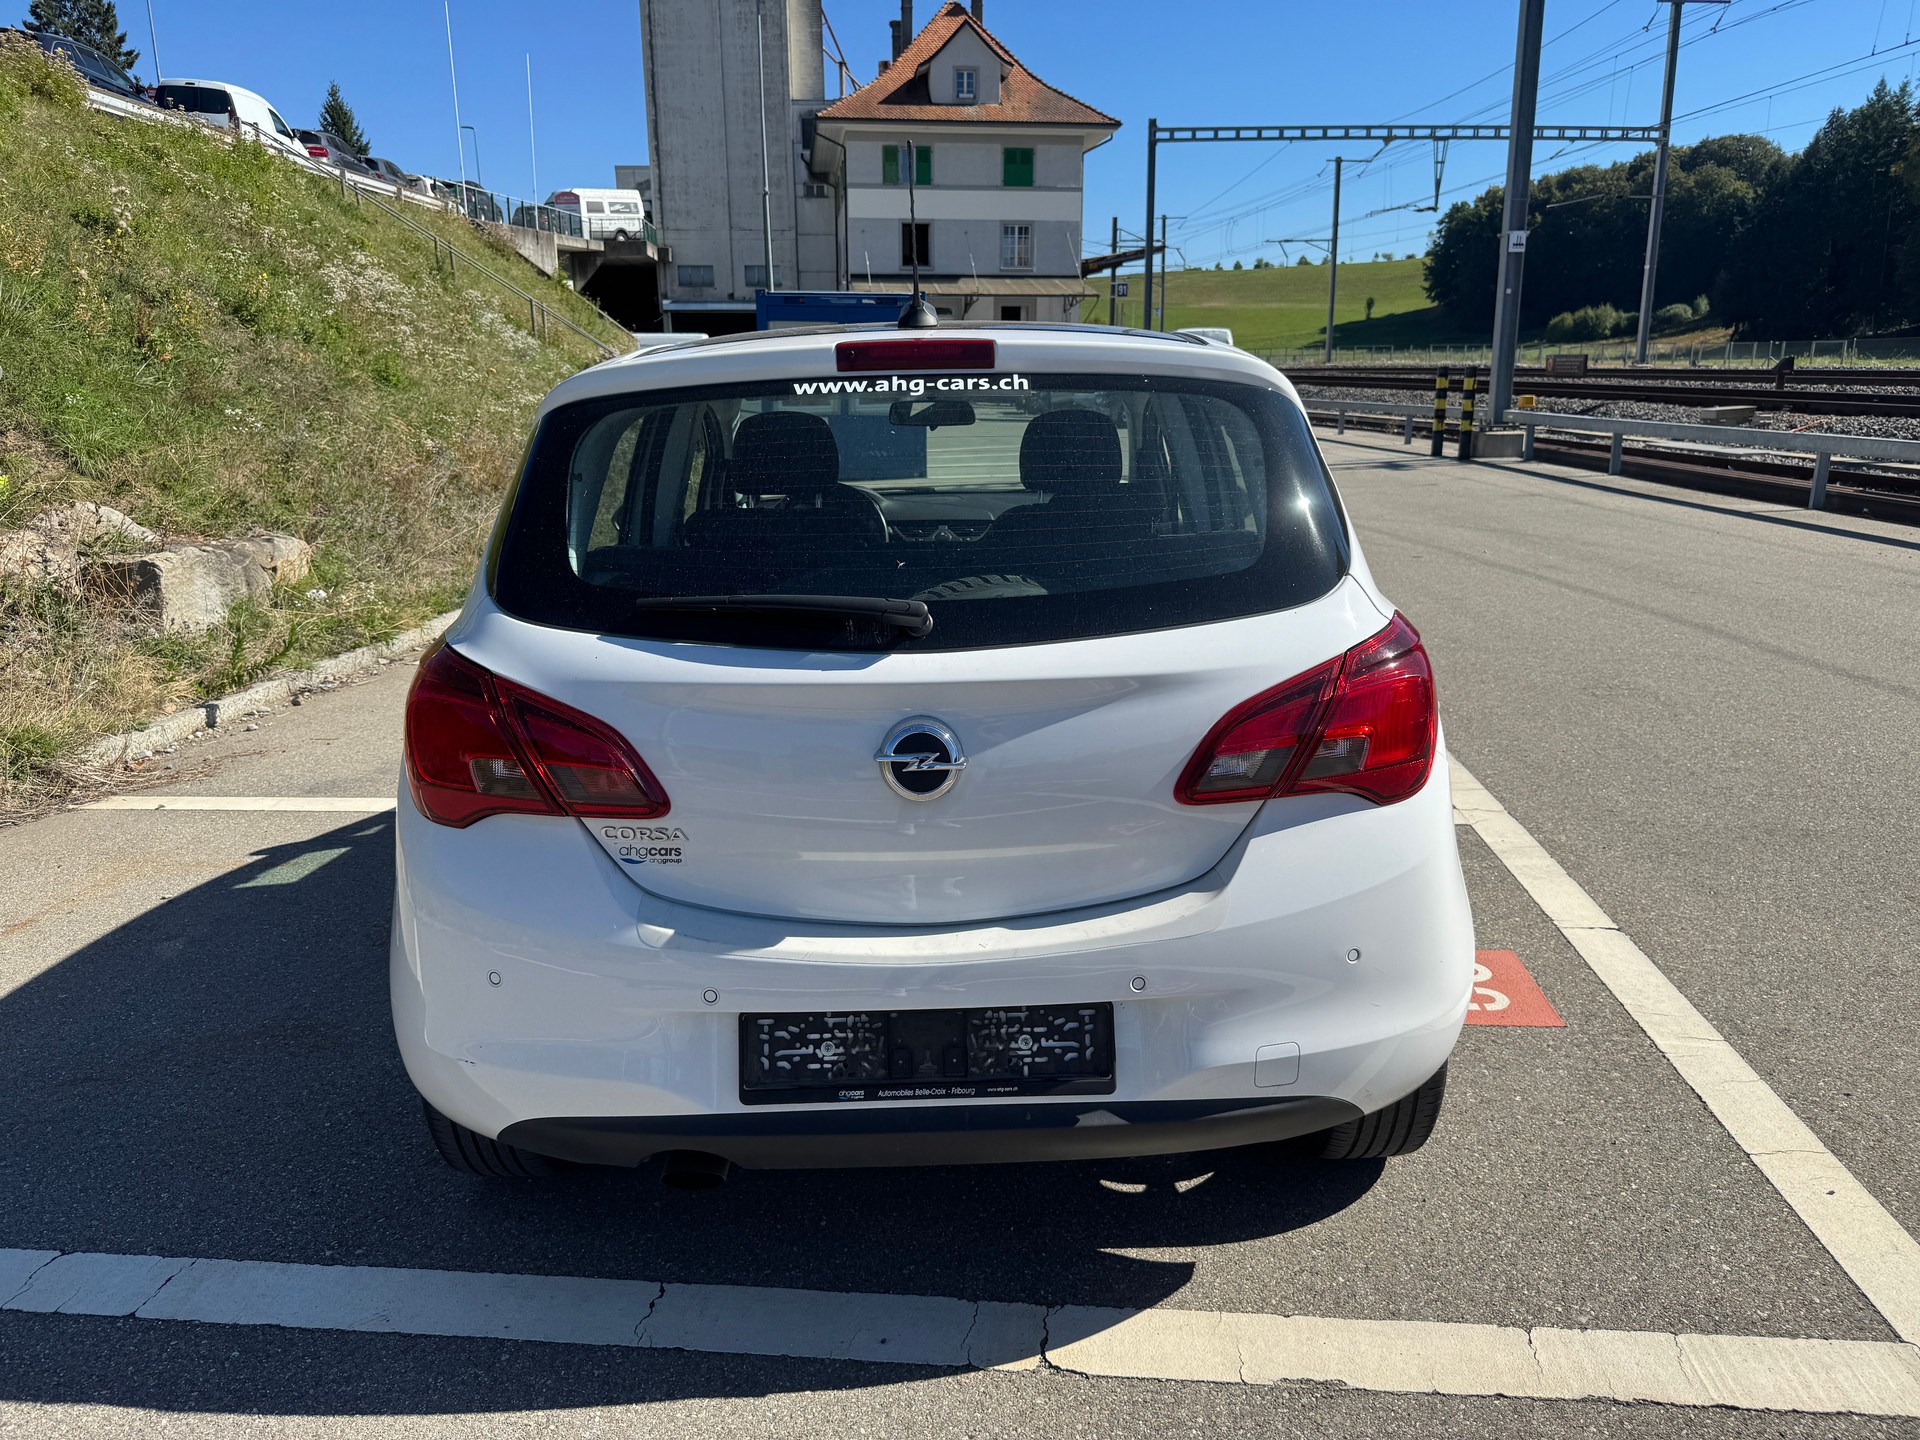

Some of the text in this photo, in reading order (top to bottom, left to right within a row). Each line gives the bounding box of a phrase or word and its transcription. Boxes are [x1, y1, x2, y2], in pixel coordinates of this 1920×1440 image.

[1118, 284, 1127, 296] 91
[793, 374, 1029, 396] www.ahg-cars.ch
[600, 826, 690, 842] CORSA
[619, 844, 682, 859] ahgcars
[878, 1089, 914, 1097] Automobiles
[915, 1087, 946, 1096] Belle-Croix
[951, 1087, 976, 1096] Fribourg
